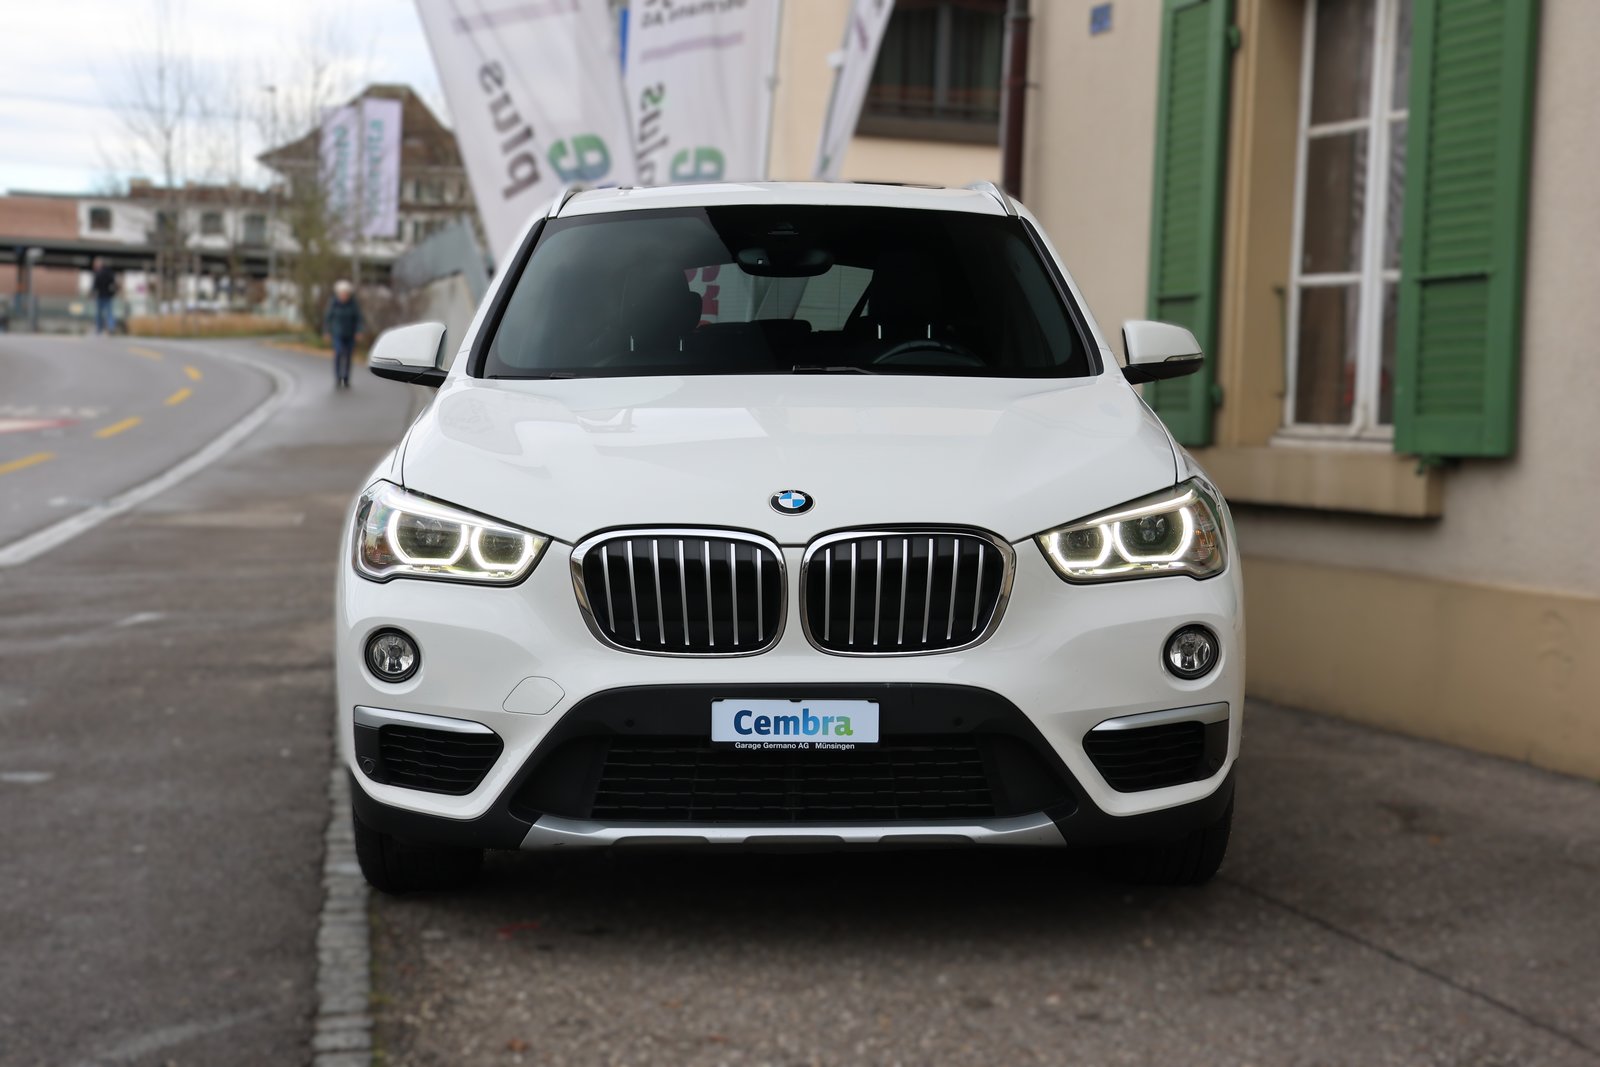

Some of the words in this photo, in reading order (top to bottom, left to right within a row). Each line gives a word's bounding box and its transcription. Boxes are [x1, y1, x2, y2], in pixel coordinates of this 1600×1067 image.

[733, 707, 854, 736] Cembra
[734, 742, 762, 751] Garage
[762, 742, 797, 750] Germano
[797, 742, 810, 750] AG
[815, 742, 855, 751] Münsingen
